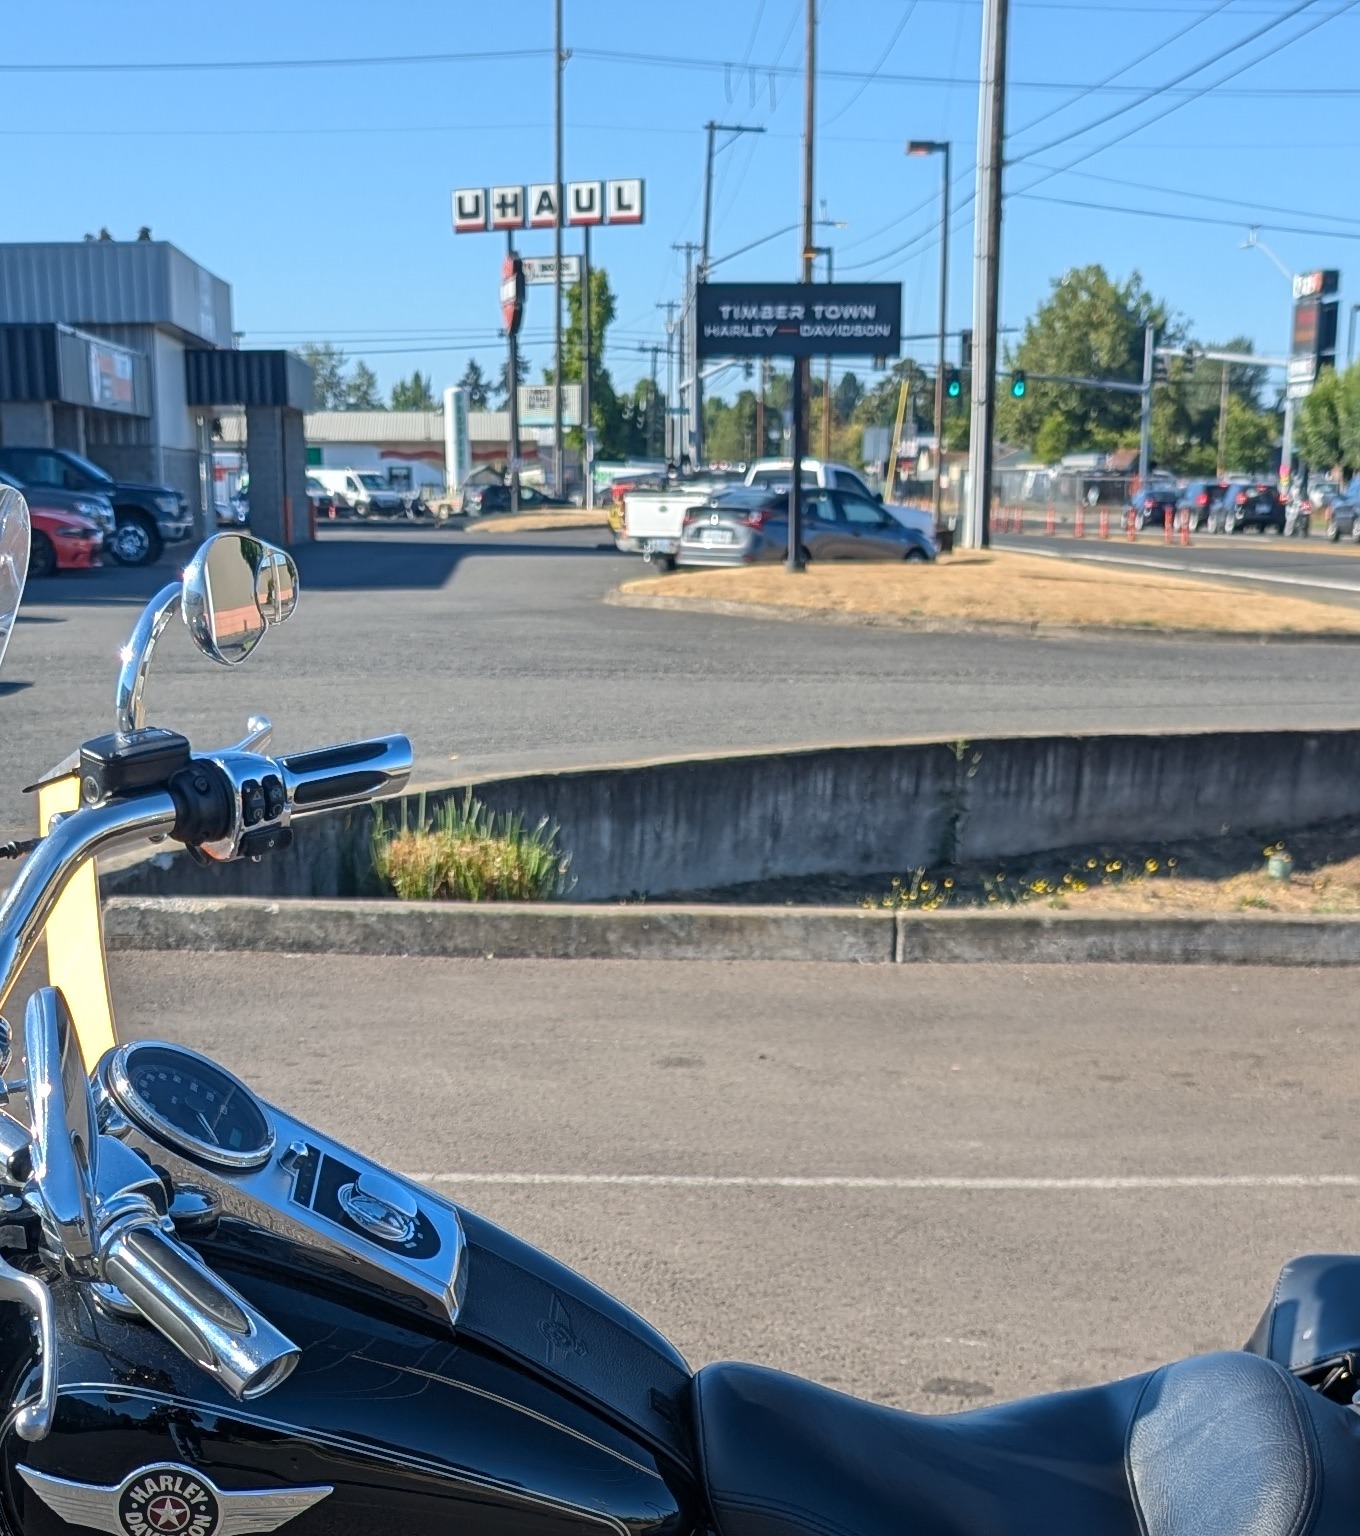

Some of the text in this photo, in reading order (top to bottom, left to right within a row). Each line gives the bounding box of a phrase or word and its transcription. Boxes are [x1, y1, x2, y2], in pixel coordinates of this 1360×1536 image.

[719, 304, 877, 321] TIMBER TOWN
[129, 1475, 209, 1505] HARLEY
